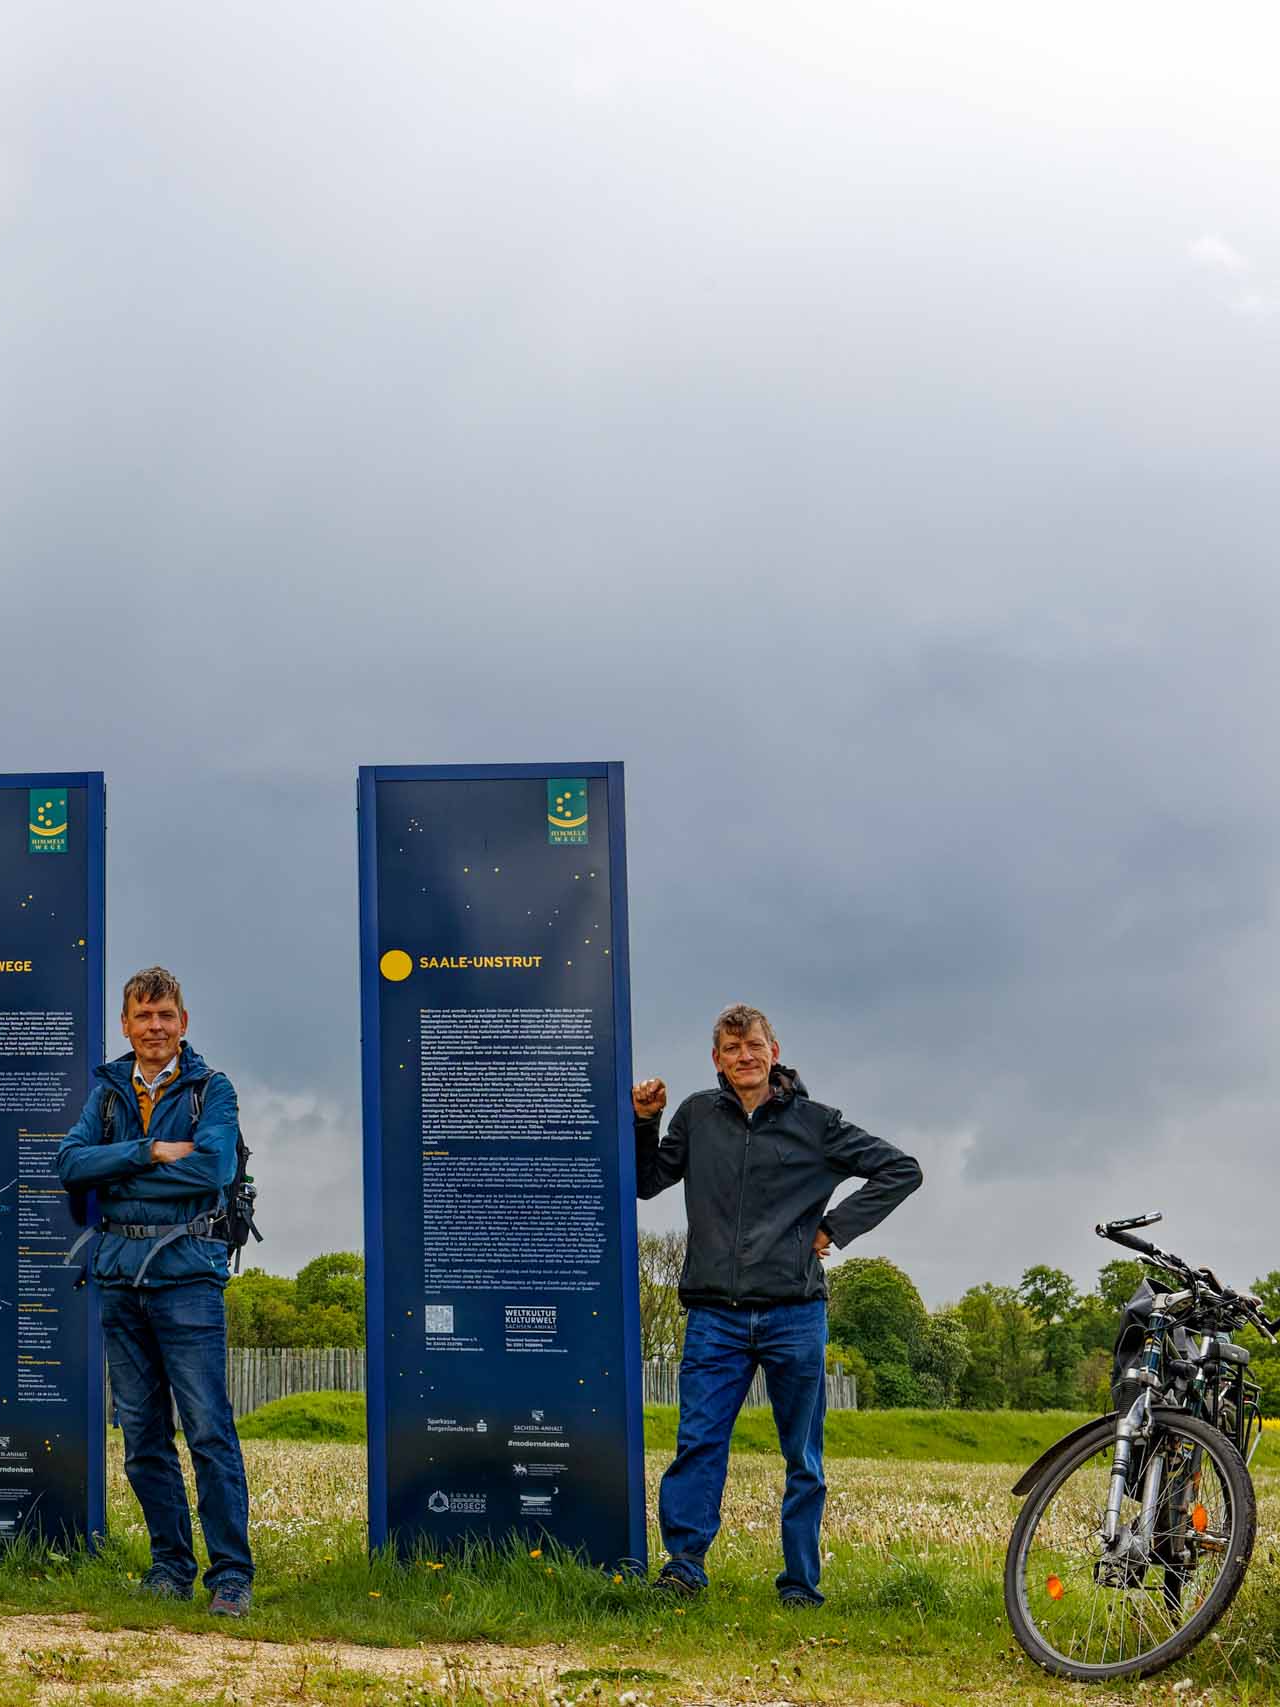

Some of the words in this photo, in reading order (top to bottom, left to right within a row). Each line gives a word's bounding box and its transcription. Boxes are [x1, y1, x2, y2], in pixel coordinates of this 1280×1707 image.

[420, 956, 543, 968] SAALE-UNSTRUT
[504, 1309, 557, 1317] WELTKULTUR
[505, 1316, 556, 1325] KULTURWELT
[450, 1502, 487, 1510] GOSECK
